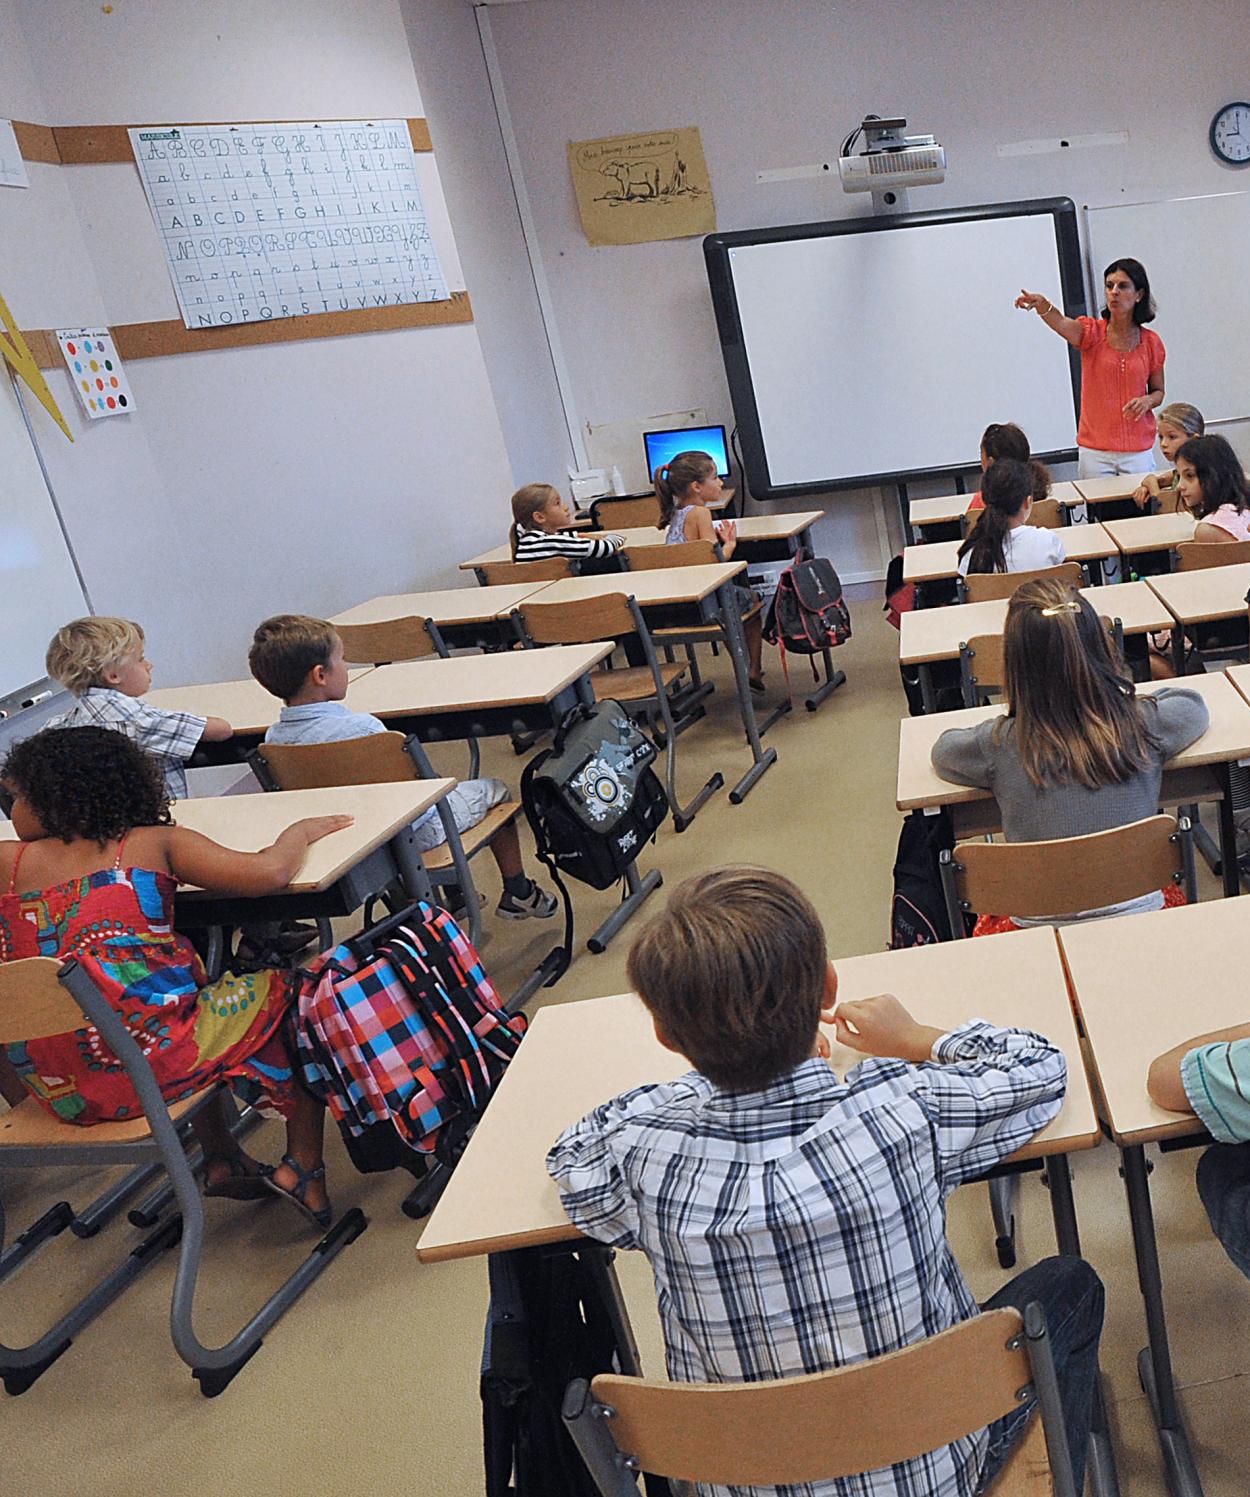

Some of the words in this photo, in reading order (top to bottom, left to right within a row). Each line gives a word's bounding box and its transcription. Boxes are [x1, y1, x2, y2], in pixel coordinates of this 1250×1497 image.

[179, 163, 190, 180] b
[224, 163, 233, 178] d
[260, 159, 272, 187] f
[285, 168, 295, 186] g
[302, 157, 314, 174] h
[324, 163, 332, 173] i
[345, 162, 352, 183] j
[360, 154, 370, 171] k
[379, 153, 388, 170] l
[187, 192, 195, 203] b
[232, 190, 238, 200] d
[292, 190, 300, 203] g
[311, 185, 318, 196] h
[352, 184, 357, 199] j
[368, 182, 374, 192] k
[172, 216, 183, 229] A
[193, 214, 203, 226] B
[214, 212, 225, 224] C
[234, 211, 245, 223] D
[256, 210, 265, 221] E
[278, 208, 284, 220] F
[295, 207, 306, 219] G
[315, 205, 326, 217] H
[357, 203, 361, 215] J
[372, 202, 381, 214] K
[392, 201, 398, 212] L
[407, 201, 418, 211] M
[198, 314, 212, 326] N
[220, 311, 232, 324] O
[242, 309, 249, 320] P
[260, 306, 272, 318] Q
[282, 305, 290, 316] R
[302, 302, 310, 314] S
[322, 300, 328, 312] T
[340, 299, 348, 310] U
[357, 296, 366, 307] V
[373, 294, 387, 305] W
[395, 292, 403, 304] X
[412, 291, 420, 302] Y
[431, 289, 438, 300] Z
